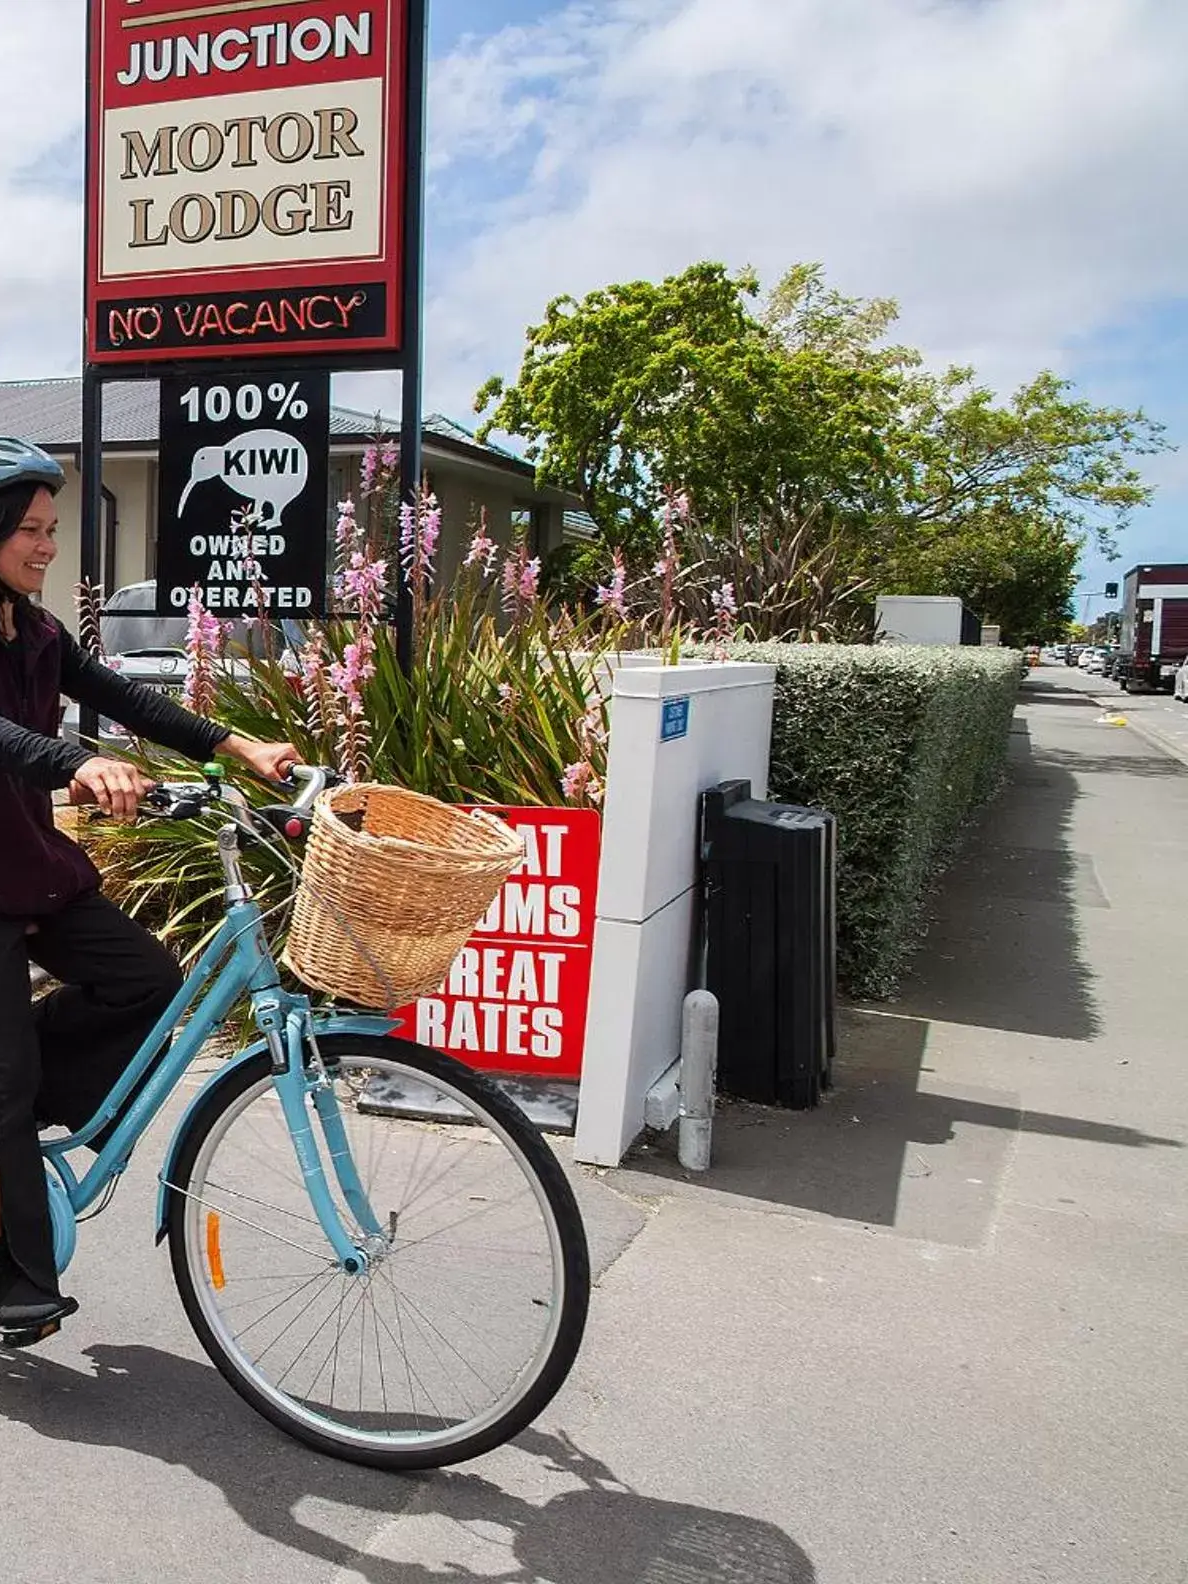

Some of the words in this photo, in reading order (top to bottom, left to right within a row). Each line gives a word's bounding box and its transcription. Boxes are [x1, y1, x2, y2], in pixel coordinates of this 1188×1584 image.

[116, 12, 372, 85] JUNCTION
[120, 107, 364, 179] MOTOR
[128, 180, 353, 248] LODGE
[109, 304, 162, 341] NO
[174, 294, 362, 338] VACANCY
[179, 381, 309, 422] 100%
[223, 447, 299, 476] KIWI
[207, 560, 262, 581] AND
[439, 947, 567, 1004] REAT
[416, 996, 564, 1059] RATES
